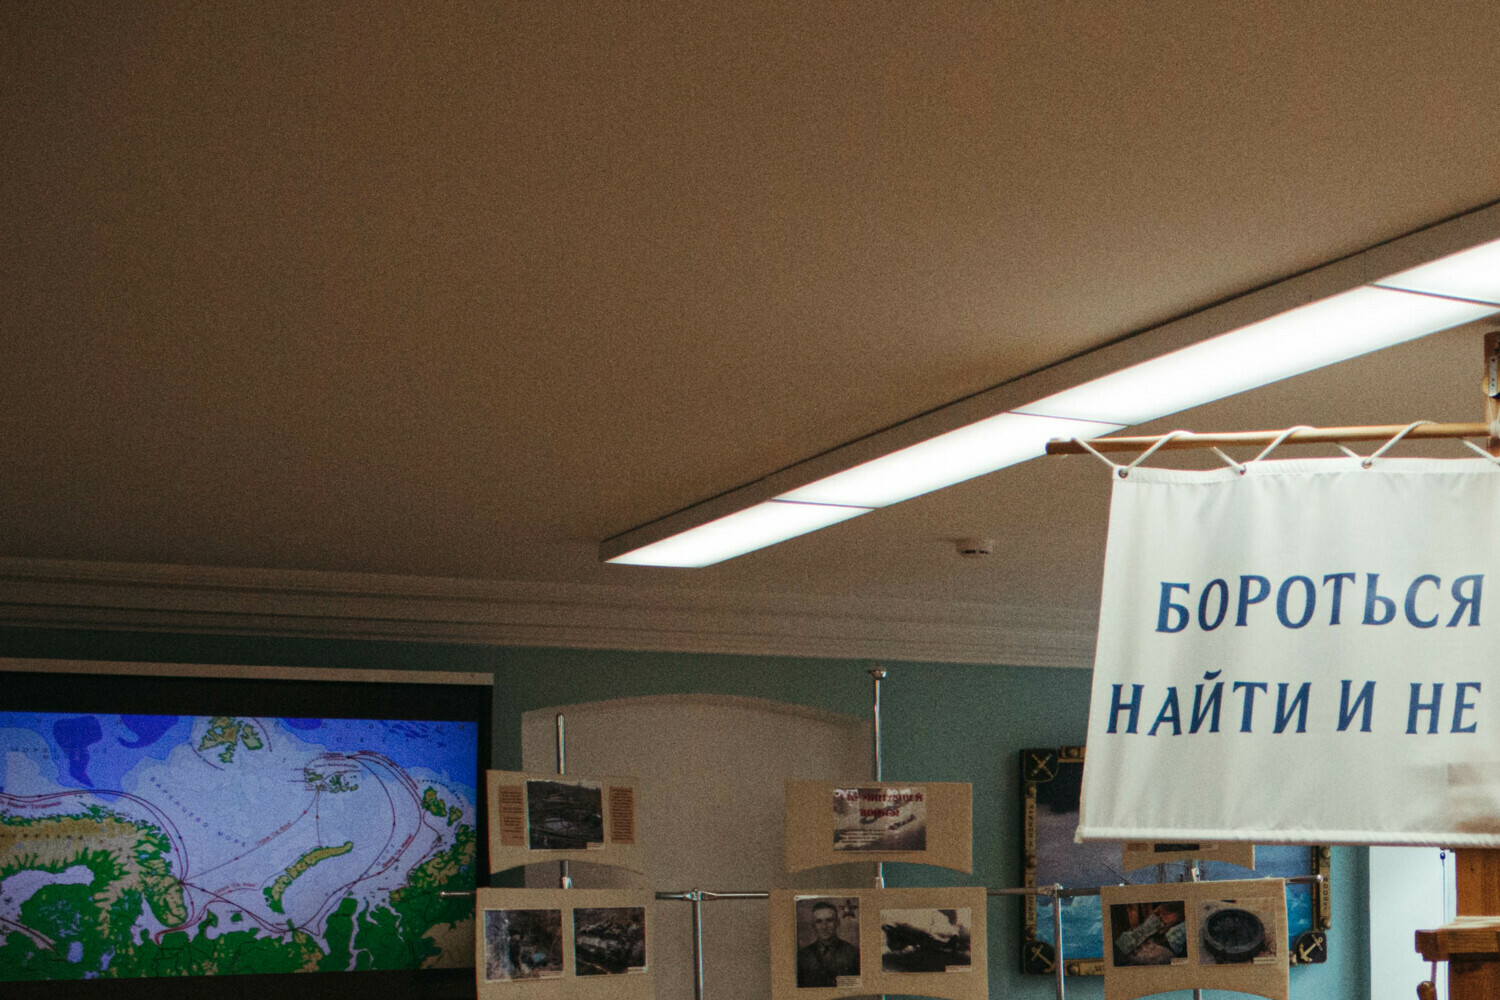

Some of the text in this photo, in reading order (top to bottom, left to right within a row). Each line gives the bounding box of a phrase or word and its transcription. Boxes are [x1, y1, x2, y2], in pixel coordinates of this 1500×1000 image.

[1155, 571, 1485, 635] БОРОТЬСЯ
[1106, 670, 1313, 737] НАЙТИ
[1336, 679, 1377, 734] И
[1405, 681, 1483, 736] НЕ
